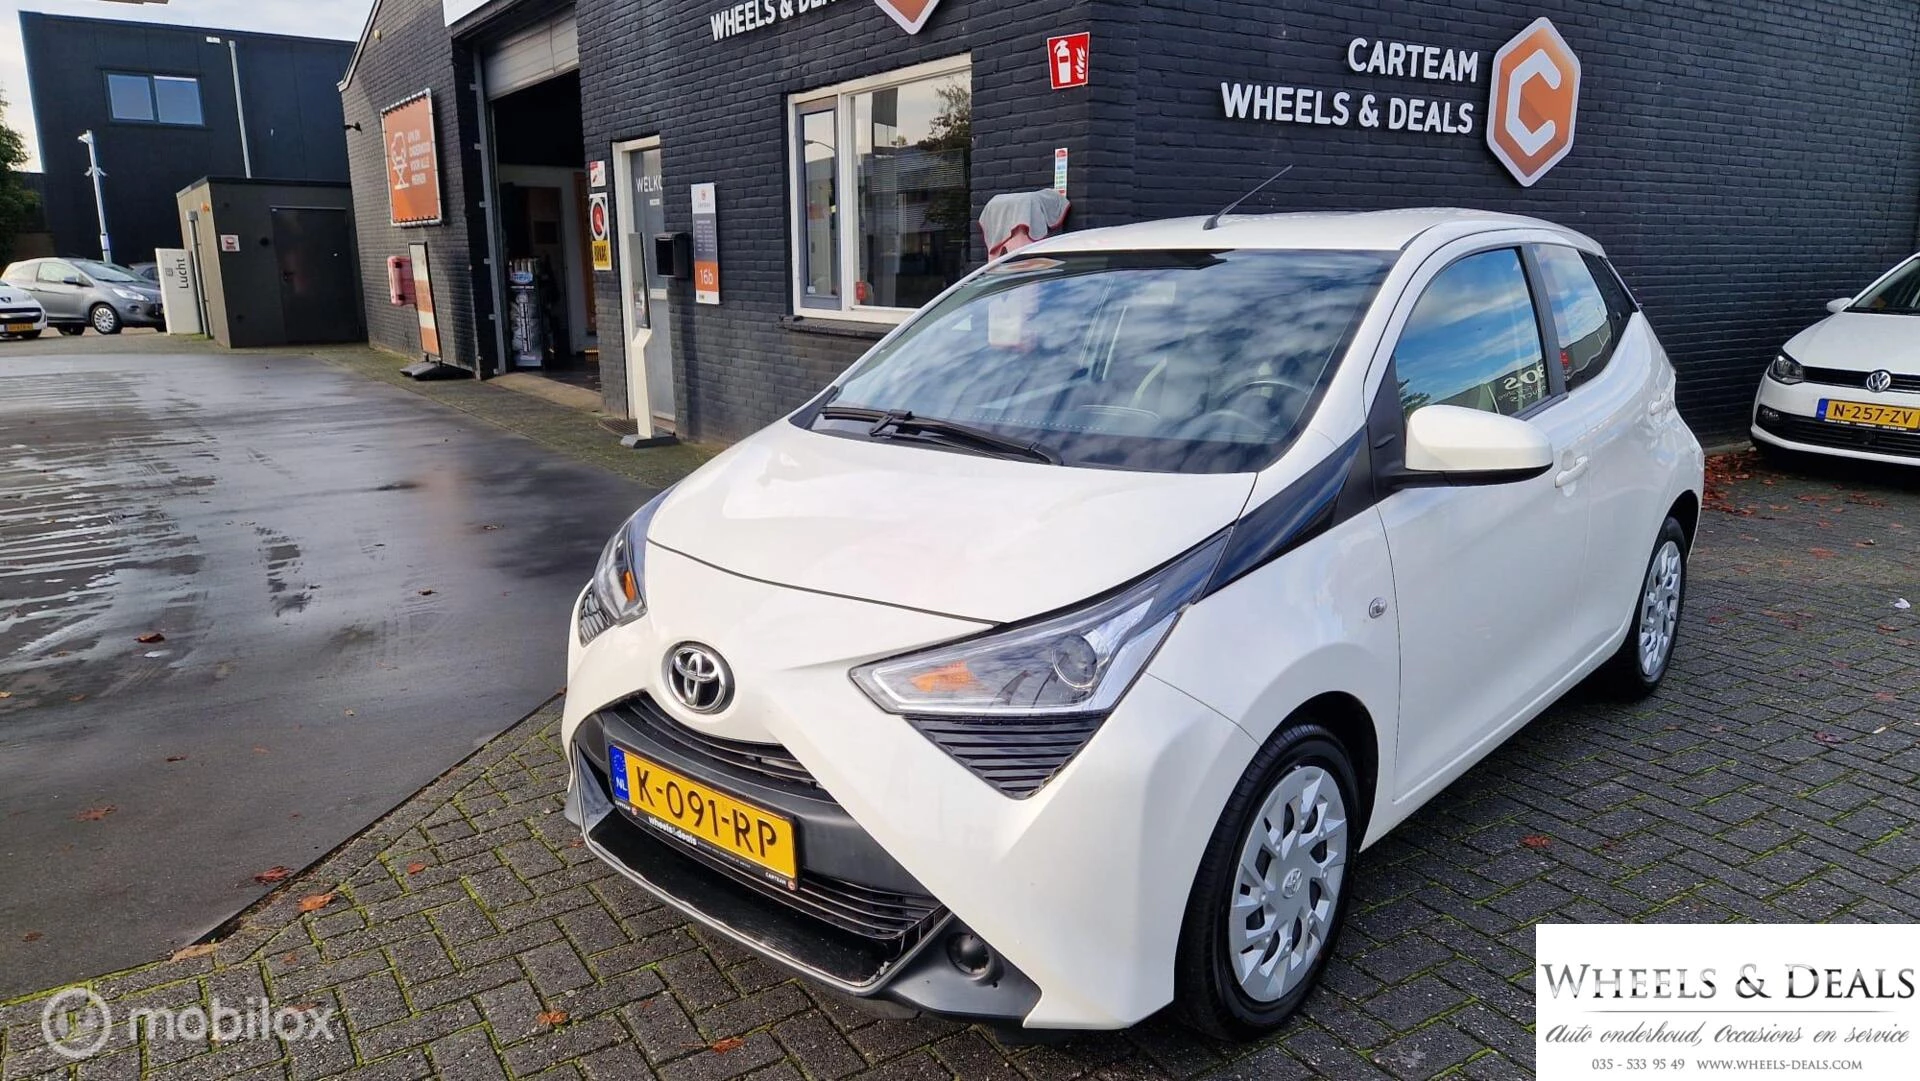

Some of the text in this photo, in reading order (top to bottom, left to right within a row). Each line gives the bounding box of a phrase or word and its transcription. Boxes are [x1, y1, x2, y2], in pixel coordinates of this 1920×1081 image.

[710, 0, 776, 41] WHEELS
[1347, 37, 1479, 83] CARTEAM
[1221, 82, 1474, 134] WHEELS & DEALS
[175, 257, 189, 289] Lucht
[700, 268, 713, 285] 16b
[1834, 404, 1913, 425] N-257-ZV
[616, 777, 628, 791] NL
[636, 766, 777, 858] K-091-RP
